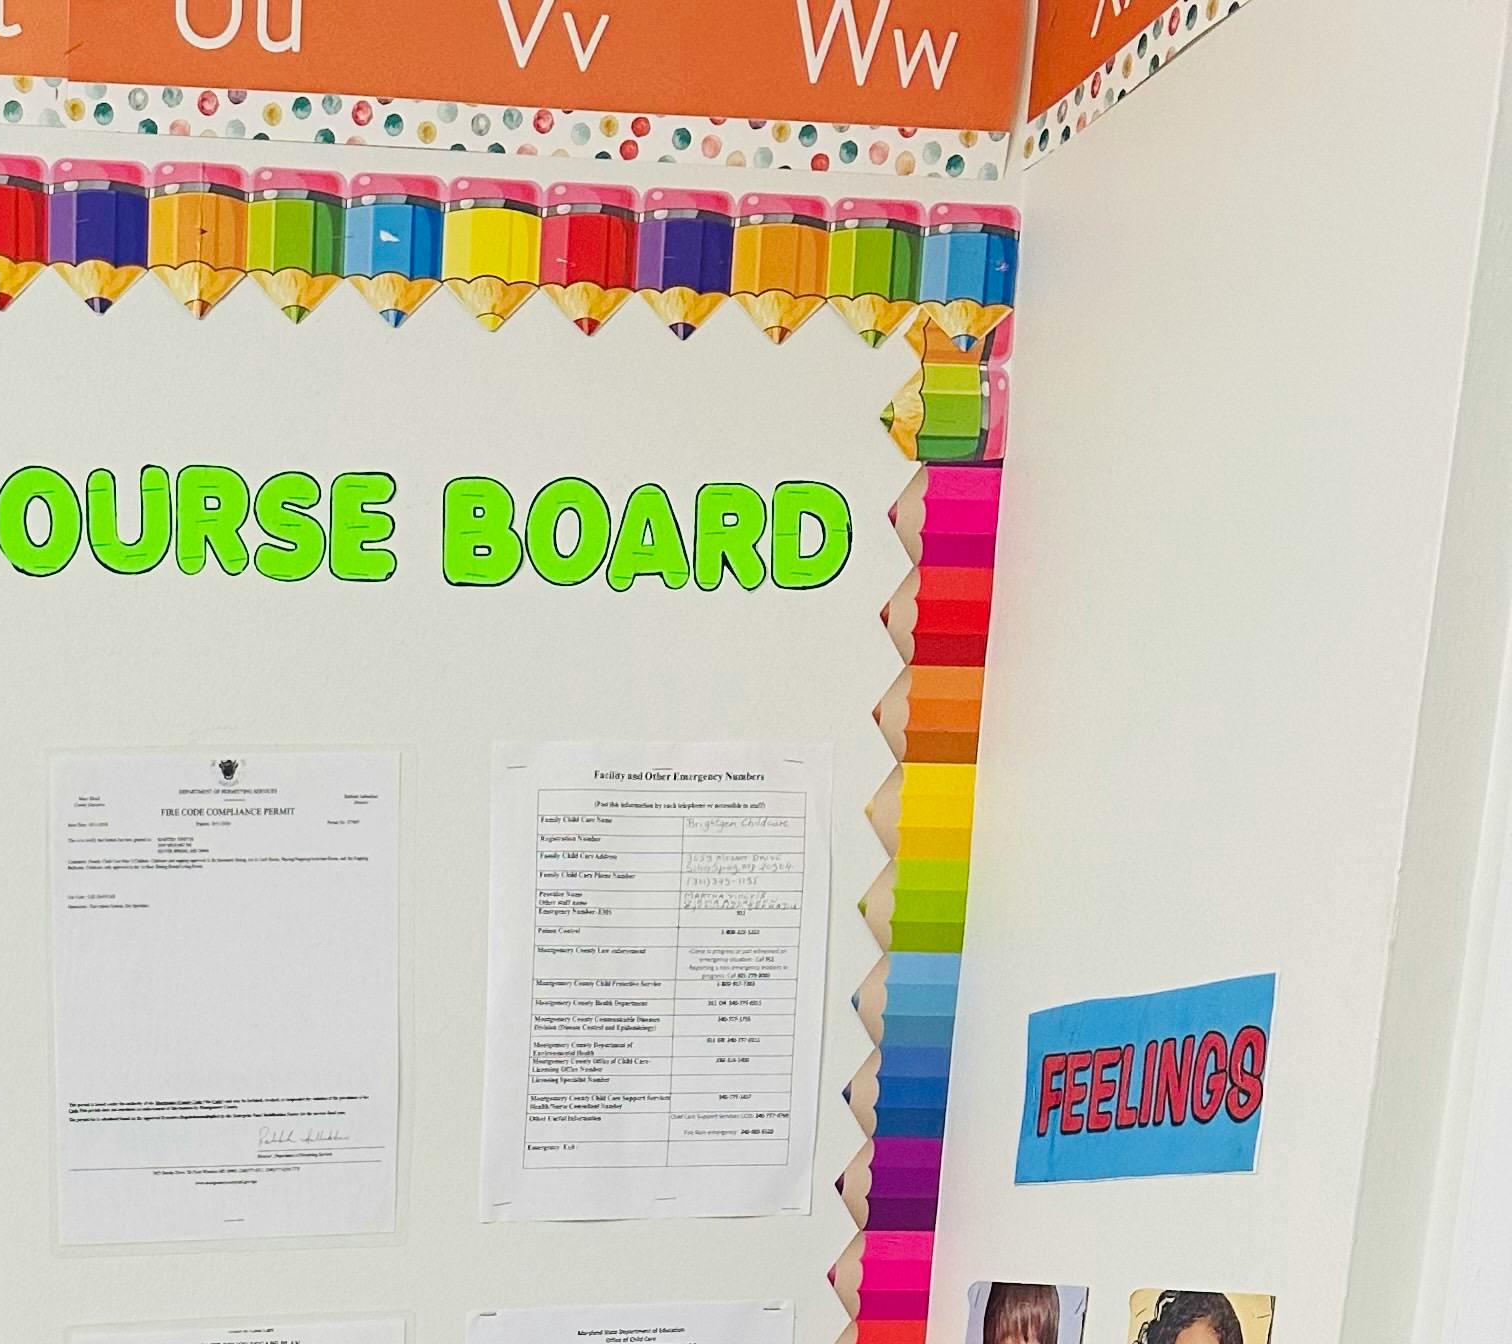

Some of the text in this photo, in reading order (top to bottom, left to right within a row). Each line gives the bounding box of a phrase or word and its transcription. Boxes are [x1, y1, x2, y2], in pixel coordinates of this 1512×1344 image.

[796, 0, 959, 91] Ww
[442, 476, 854, 594] BOARD
[161, 808, 179, 816] FIRE
[181, 808, 204, 816] CODE
[206, 808, 262, 816] COMPLIANCE
[594, 771, 765, 782] Facility and Other Emergency Numbers
[1037, 1025, 1267, 1138] FEELINGS
